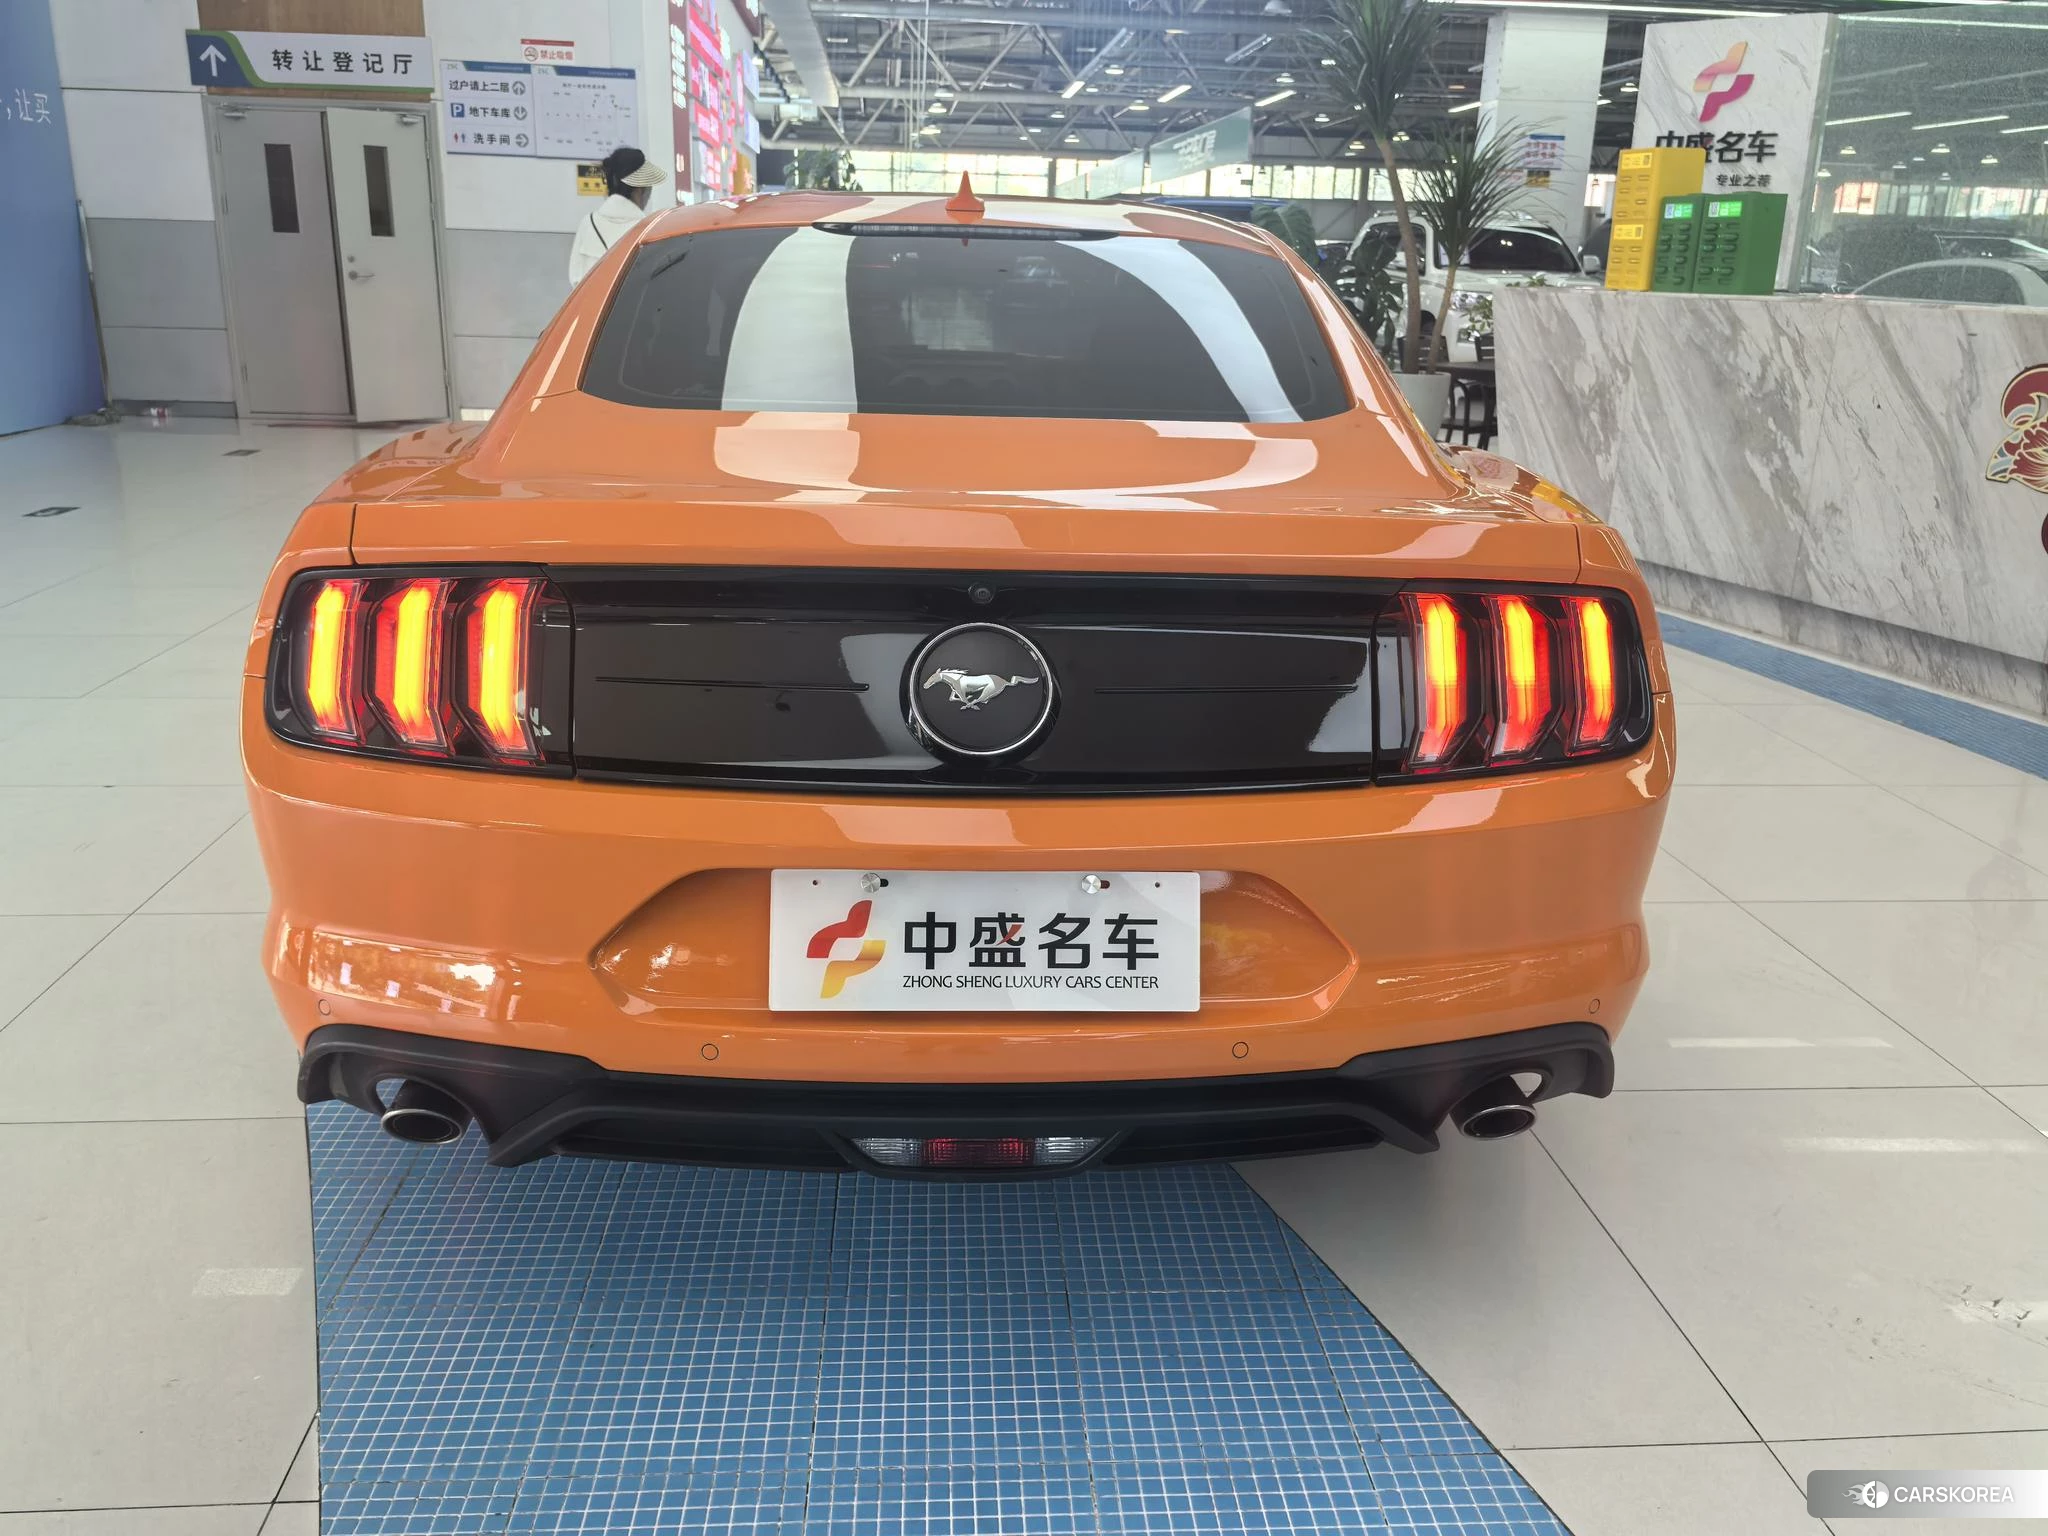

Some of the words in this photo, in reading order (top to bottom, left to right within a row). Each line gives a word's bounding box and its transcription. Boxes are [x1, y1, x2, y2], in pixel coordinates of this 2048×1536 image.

[540, 49, 574, 61] 禁止吸烟
[271, 49, 413, 75] 转让登记厅
[448, 80, 510, 93] 过户请上二层
[469, 106, 511, 118] 地下车库
[473, 132, 511, 145] 洗手间
[902, 911, 1160, 971] 中盛名车
[902, 975, 953, 989] ZHONG
[955, 975, 1003, 989] SHENG
[1005, 975, 1062, 989] LUXURY
[1066, 975, 1102, 989] CARS
[1105, 975, 1159, 989] CENTER
